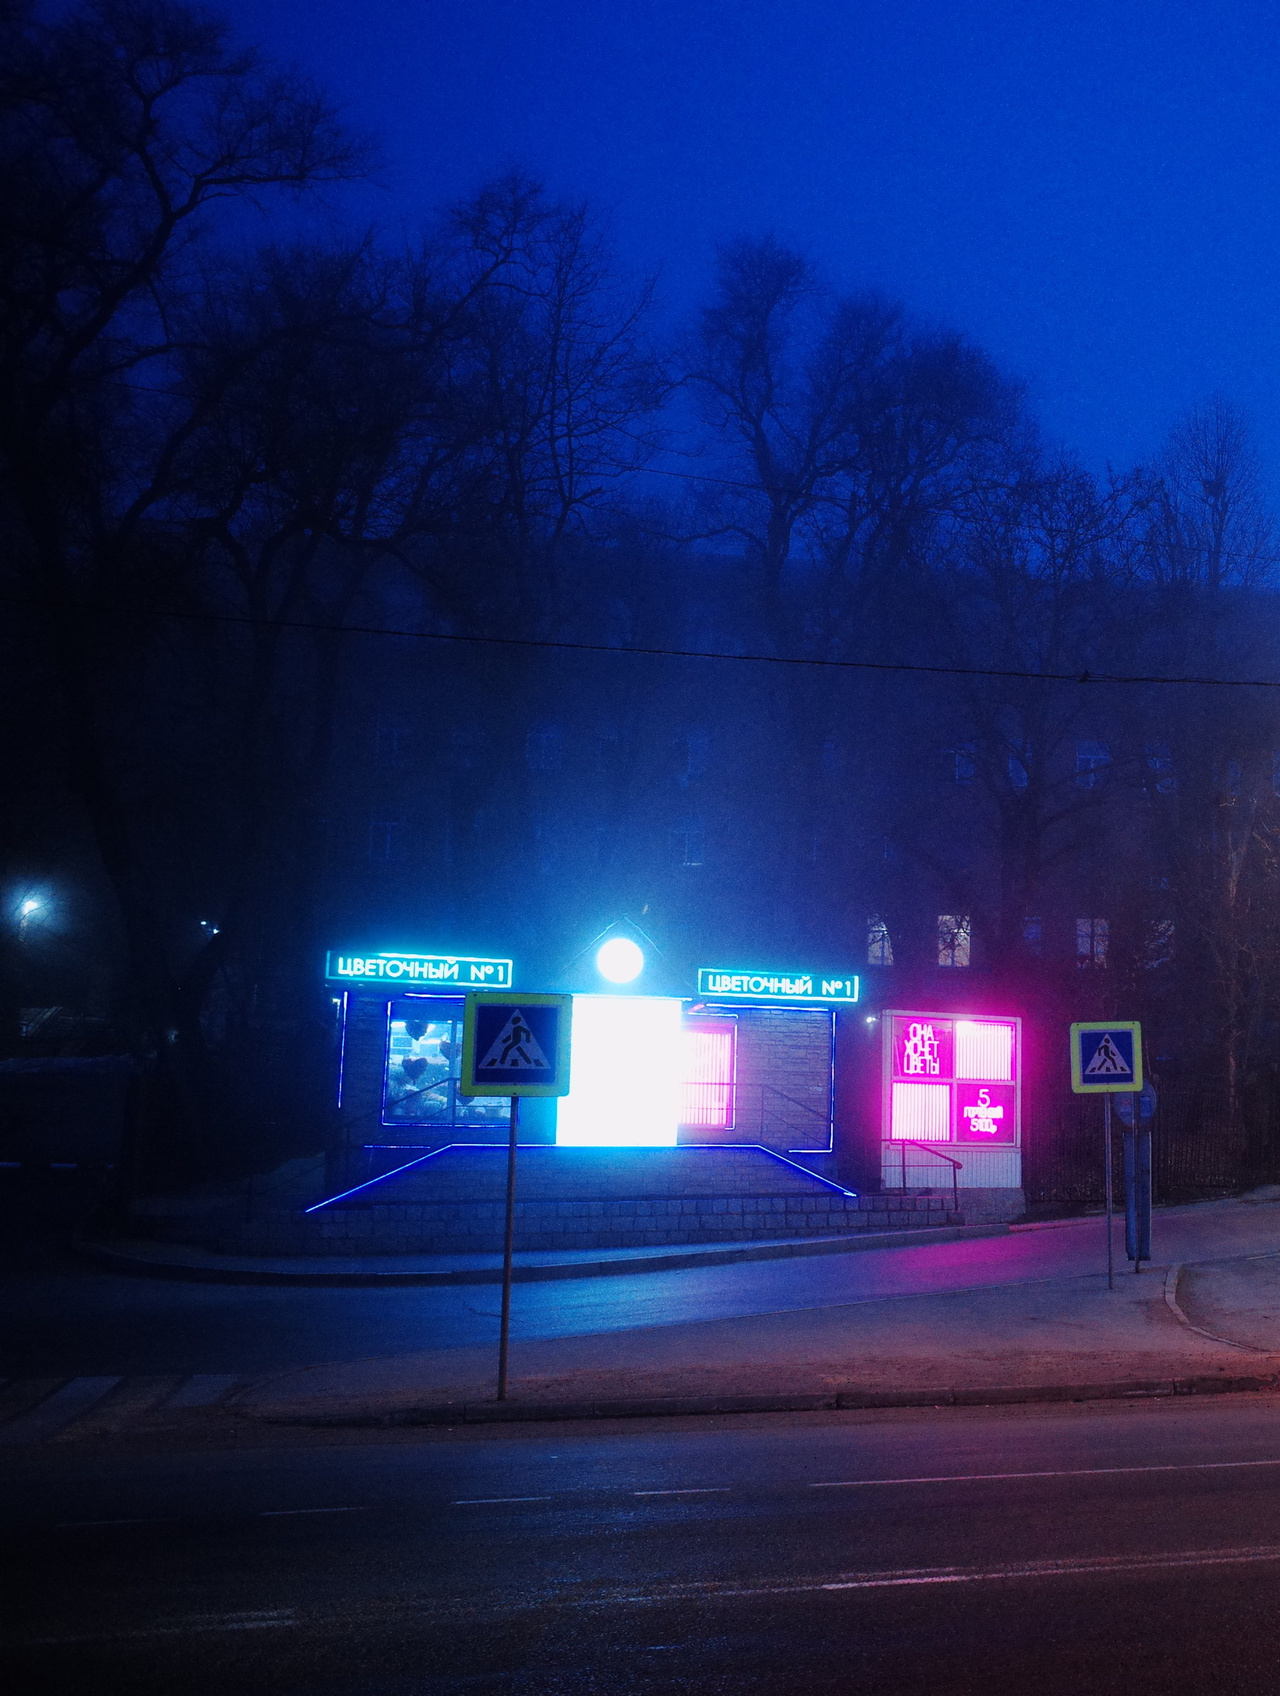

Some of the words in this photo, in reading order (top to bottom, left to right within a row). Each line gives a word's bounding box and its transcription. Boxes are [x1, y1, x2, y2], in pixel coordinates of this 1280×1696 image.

[338, 957, 459, 980] ЦВЕТОЧНЫЙ
[708, 974, 813, 995] ЦВЕТОЧНЫЙ
[909, 1023, 935, 1041] ОНА
[904, 1039, 940, 1058] ХОЧЕТ
[903, 1055, 940, 1075] ЦВЕТЫ
[977, 1088, 991, 1108] 5
